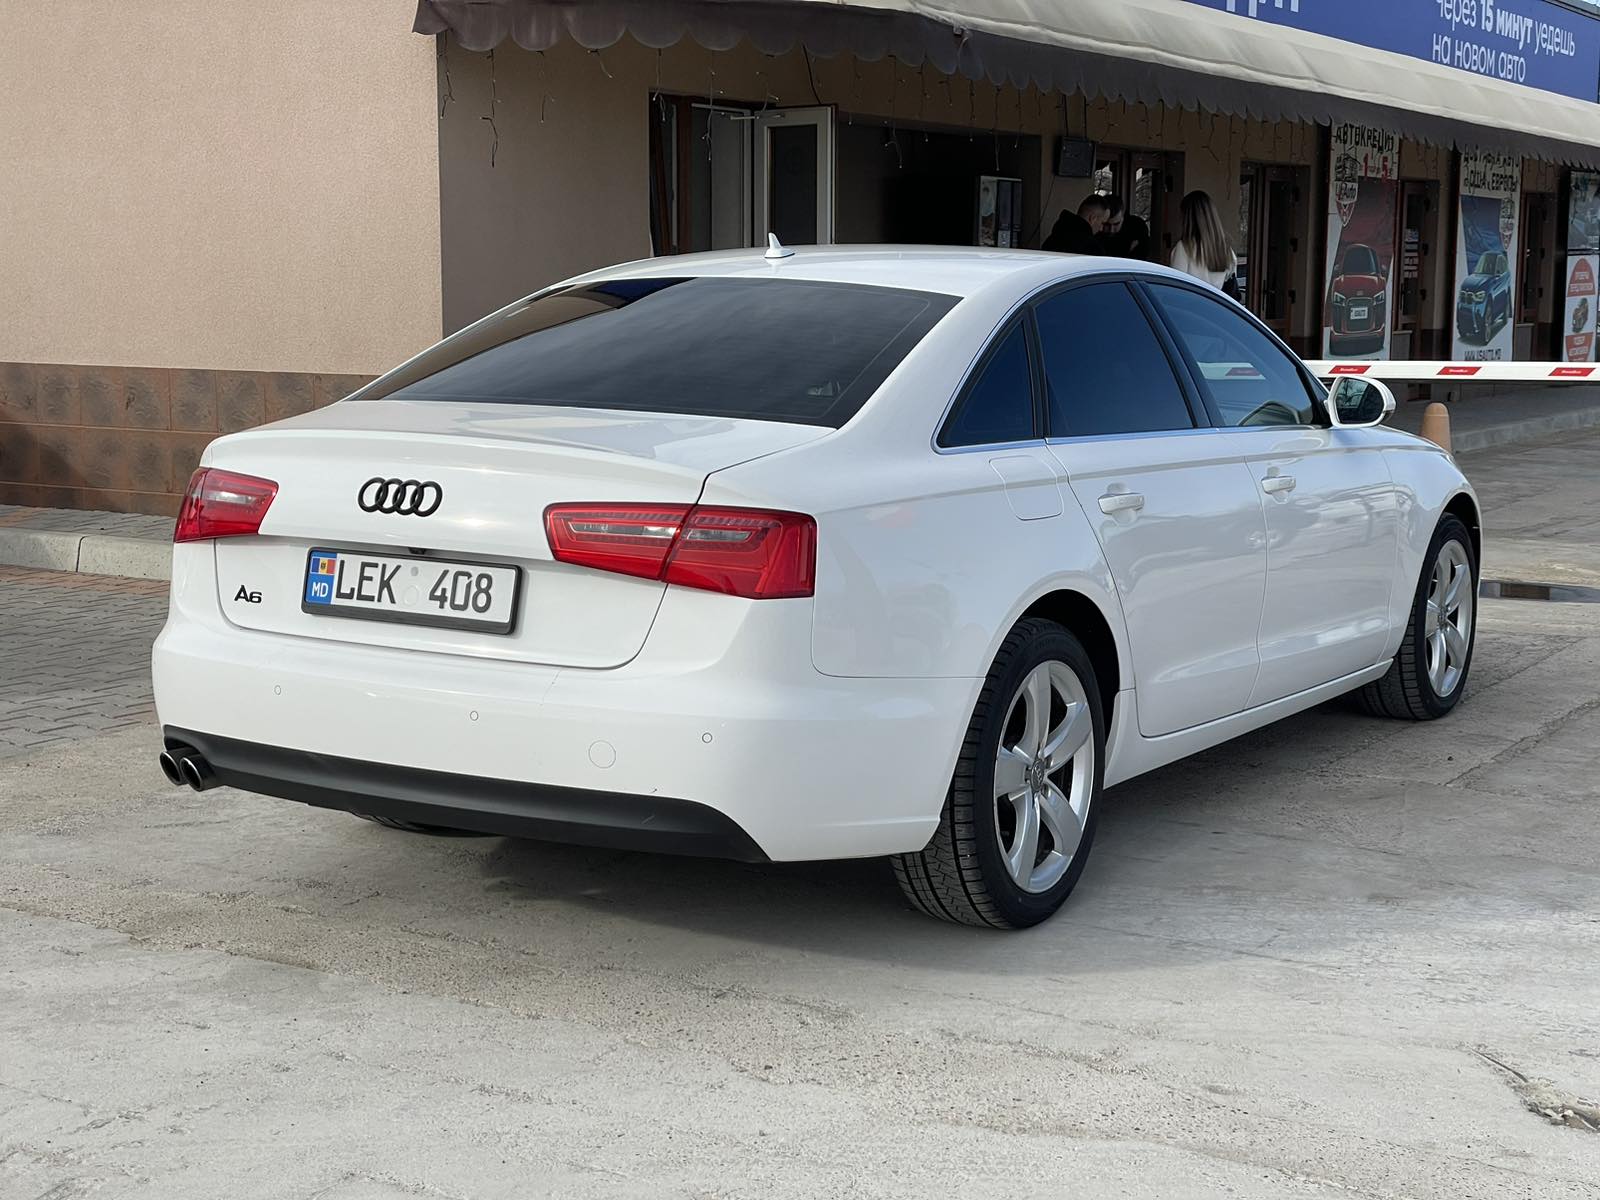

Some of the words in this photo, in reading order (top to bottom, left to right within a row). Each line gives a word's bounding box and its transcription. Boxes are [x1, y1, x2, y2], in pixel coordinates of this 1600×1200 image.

[1436, 0, 1476, 31] через
[1480, 0, 1493, 32] 15
[1496, 8, 1532, 50] минут
[1535, 20, 1575, 57] уедешь
[1432, 33, 1451, 64] на
[1454, 39, 1496, 76] новом
[1498, 52, 1526, 82] авто
[234, 584, 263, 604] A6
[311, 581, 329, 598] MD
[335, 559, 402, 604] LEK
[429, 569, 493, 614] 408
